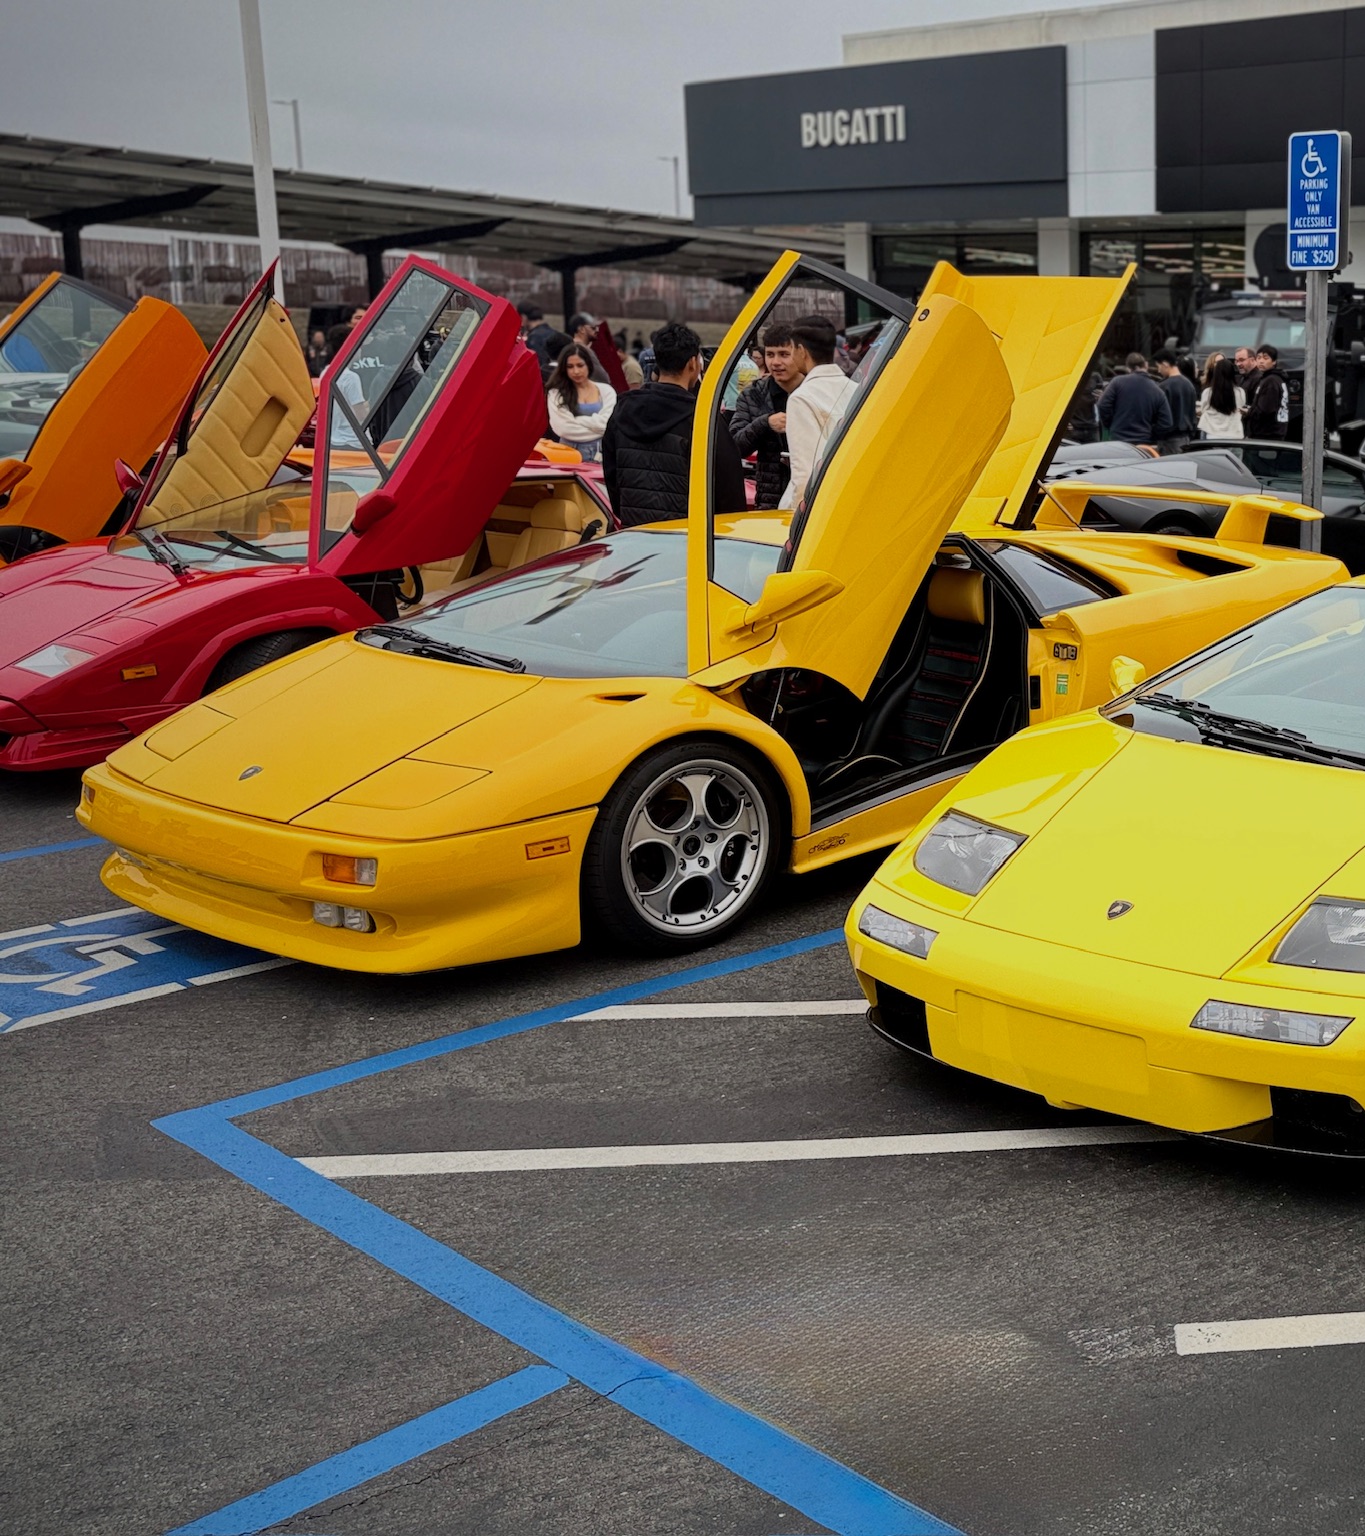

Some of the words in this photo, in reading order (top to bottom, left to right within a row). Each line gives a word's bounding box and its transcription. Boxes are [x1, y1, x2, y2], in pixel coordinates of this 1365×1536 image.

[801, 104, 906, 148] BUGATTI
[1300, 178, 1328, 190] PARKING
[1305, 191, 1322, 202] ONLY
[1307, 204, 1320, 215] VAN
[1294, 216, 1332, 227] ACCESSIBLE
[1297, 235, 1329, 248] MINIMUM
[1291, 250, 1308, 264] FINE
[1312, 249, 1334, 264] $250
